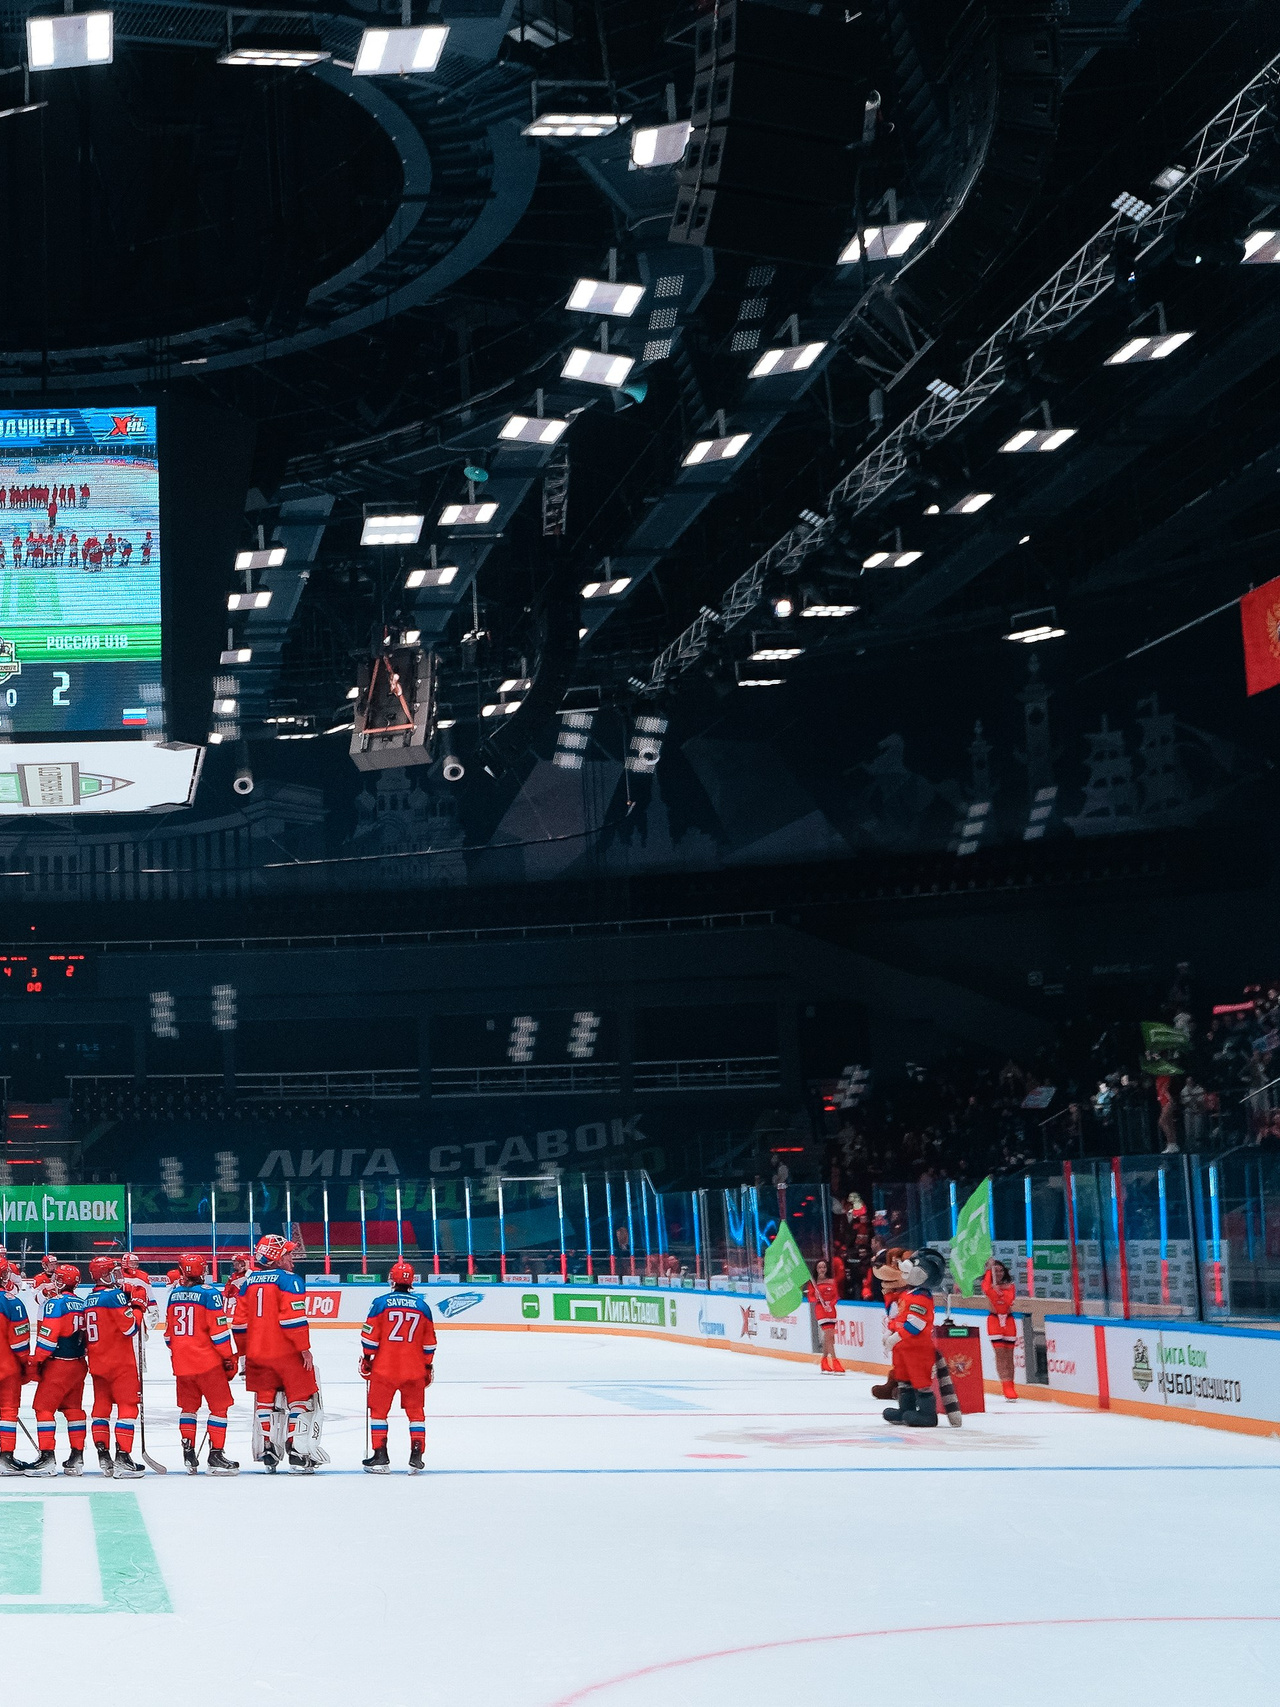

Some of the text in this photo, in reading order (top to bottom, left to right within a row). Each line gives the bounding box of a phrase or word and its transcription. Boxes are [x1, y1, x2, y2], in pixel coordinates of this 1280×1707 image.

[46, 633, 129, 650] РОССИЯ U18
[52, 671, 71, 706] 2
[257, 1113, 648, 1178] ЛИГА СТАВОК
[42, 1196, 119, 1222] Ставок
[116, 1292, 127, 1306] 16
[293, 1280, 300, 1293] 1
[16, 1305, 23, 1318] 7
[256, 1287, 264, 1317] 1
[386, 1298, 417, 1308] SAVCHIK
[604, 1295, 660, 1325] Лига Ставок
[173, 1305, 195, 1337] 31
[388, 1310, 421, 1343] 27
